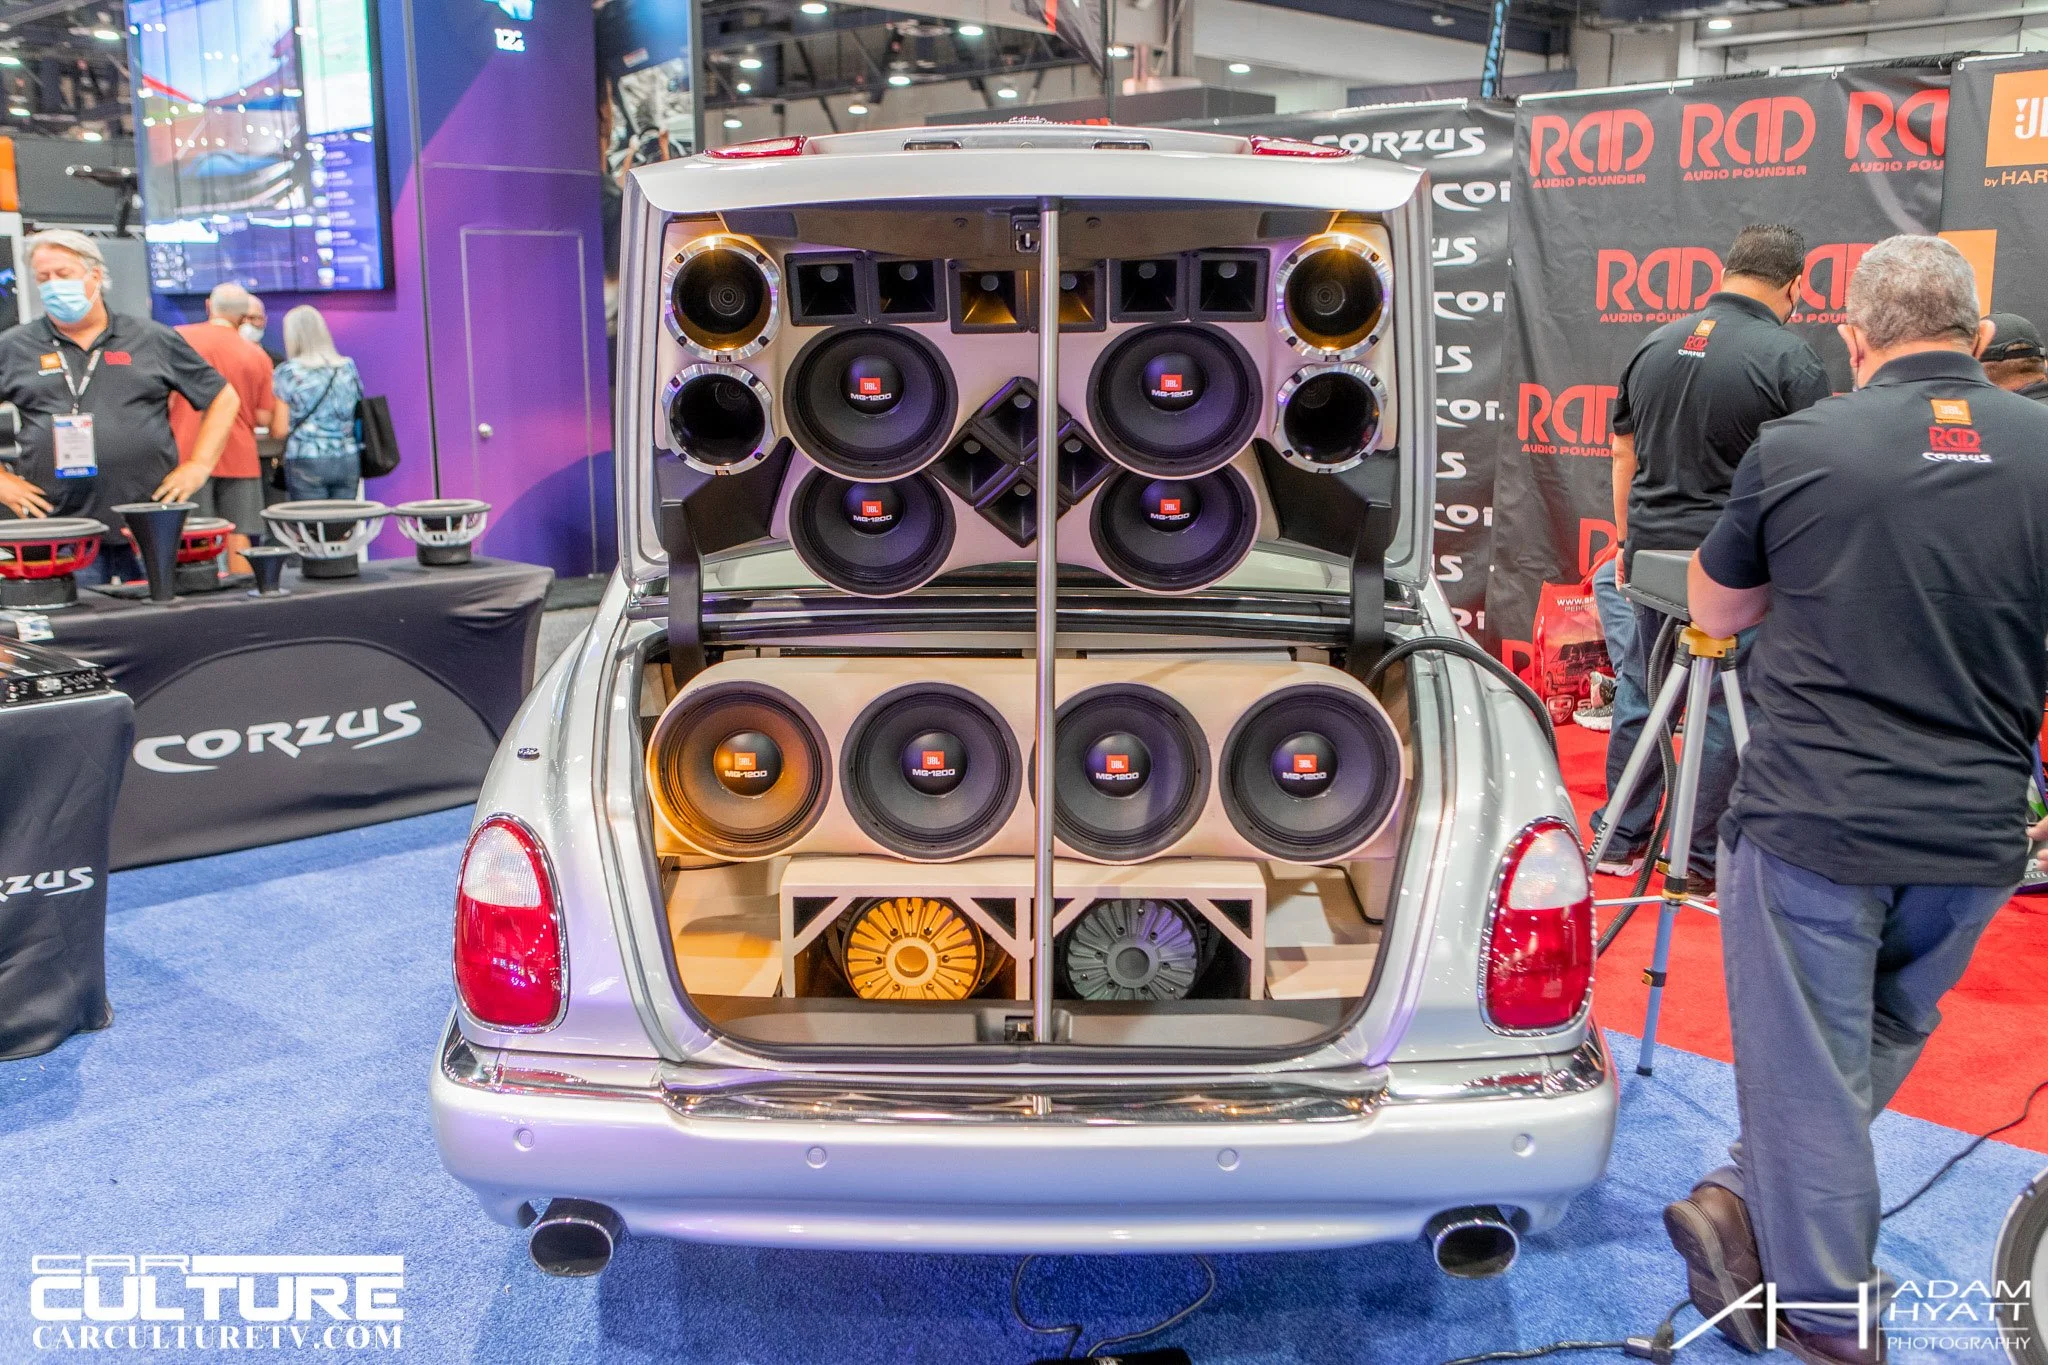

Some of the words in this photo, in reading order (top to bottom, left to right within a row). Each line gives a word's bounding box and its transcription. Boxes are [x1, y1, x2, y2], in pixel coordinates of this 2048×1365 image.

[1683, 169, 1729, 181] AUDIO
[1732, 165, 1807, 178] POUNDER
[1849, 161, 1903, 173] AUDIO
[1532, 176, 1575, 189] AUDIO
[1577, 173, 1646, 186] POUNDER
[1984, 178, 1998, 187] by
[1600, 313, 1643, 323] AUDIO
[1522, 444, 1557, 455] AUDIO
[133, 700, 422, 772] CORZUS
